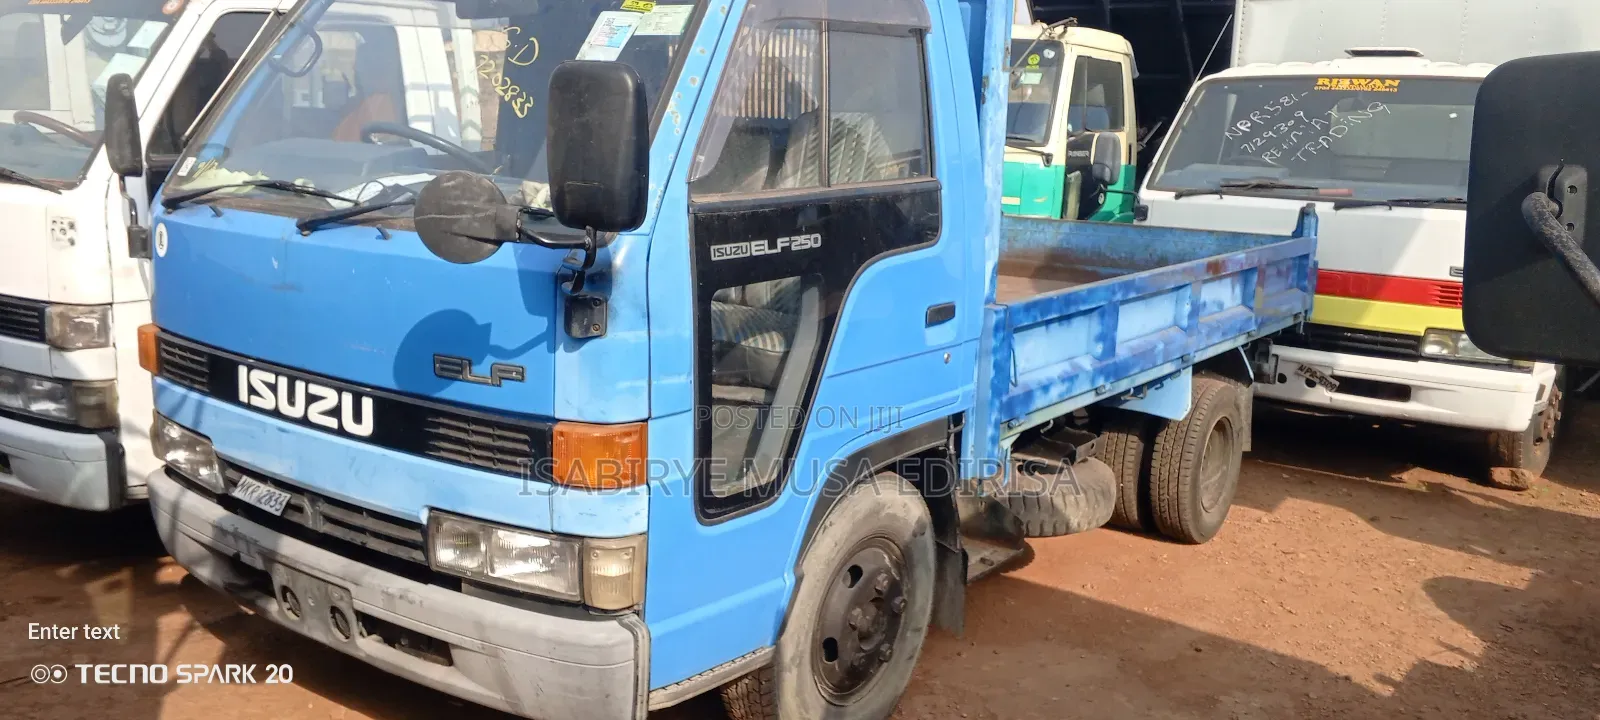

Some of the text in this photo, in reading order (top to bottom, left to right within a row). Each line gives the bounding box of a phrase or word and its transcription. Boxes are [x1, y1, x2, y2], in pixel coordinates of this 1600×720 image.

[711, 243, 750, 260] ISUZU
[433, 353, 526, 387] ELF
[238, 364, 375, 437] ISUZU
